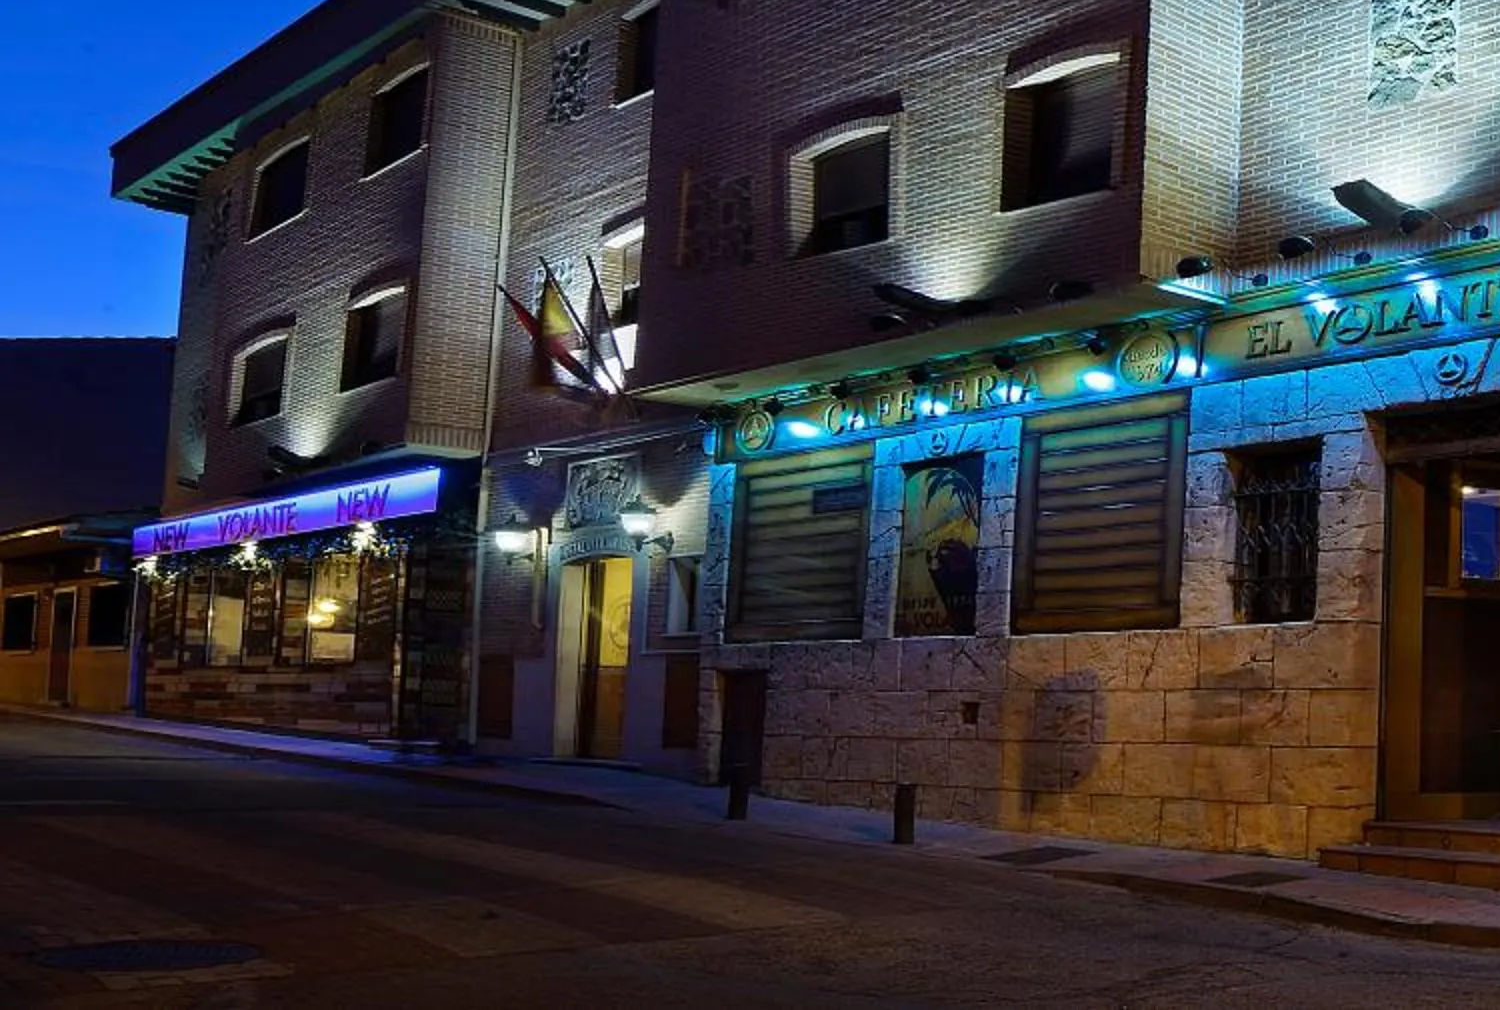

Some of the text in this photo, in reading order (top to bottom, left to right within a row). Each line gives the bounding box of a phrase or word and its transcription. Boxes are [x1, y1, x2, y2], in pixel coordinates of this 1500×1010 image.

[1245, 318, 1292, 359] EL
[153, 484, 391, 552] NEW VOLANTE NEW
